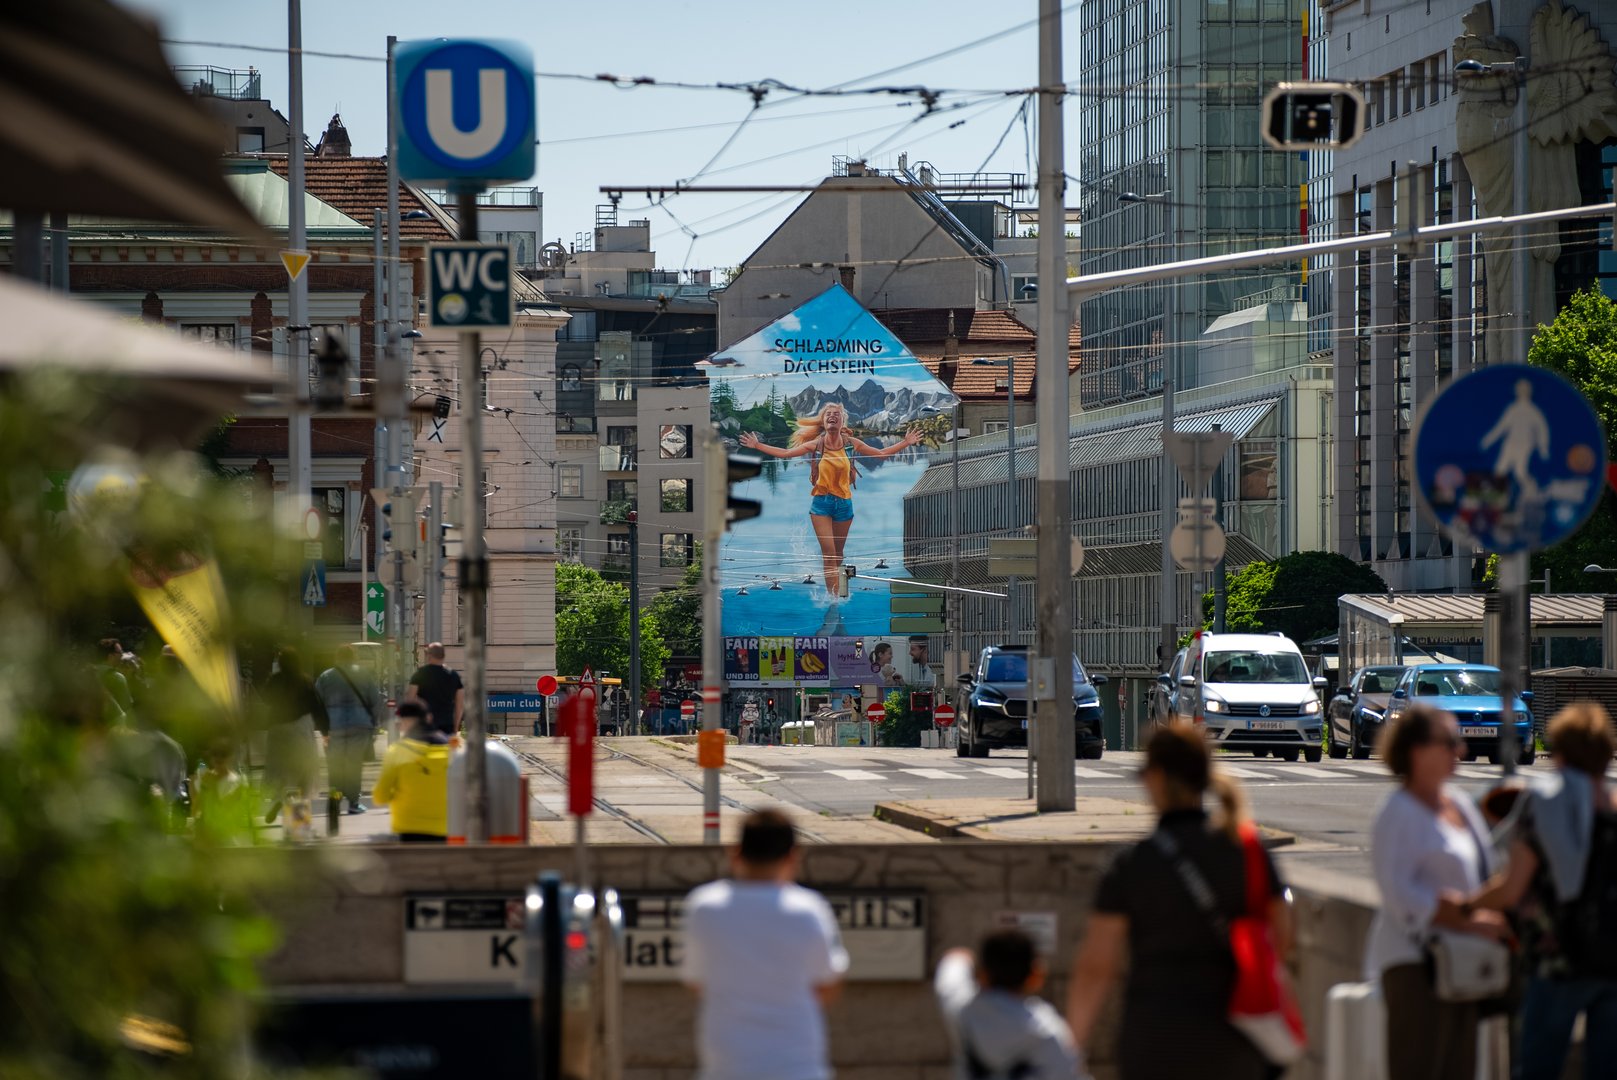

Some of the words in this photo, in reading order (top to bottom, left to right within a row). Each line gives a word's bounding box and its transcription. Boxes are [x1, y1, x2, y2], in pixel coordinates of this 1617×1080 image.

[425, 69, 506, 159] U
[434, 251, 506, 291] WC
[775, 338, 882, 354] SCHLADMING
[784, 357, 875, 377] DACHSTEIN
[725, 637, 759, 650] FAIR
[760, 637, 794, 650] FAIR
[795, 637, 828, 650] FAIR
[487, 699, 516, 707] lumni
[519, 699, 541, 707] club
